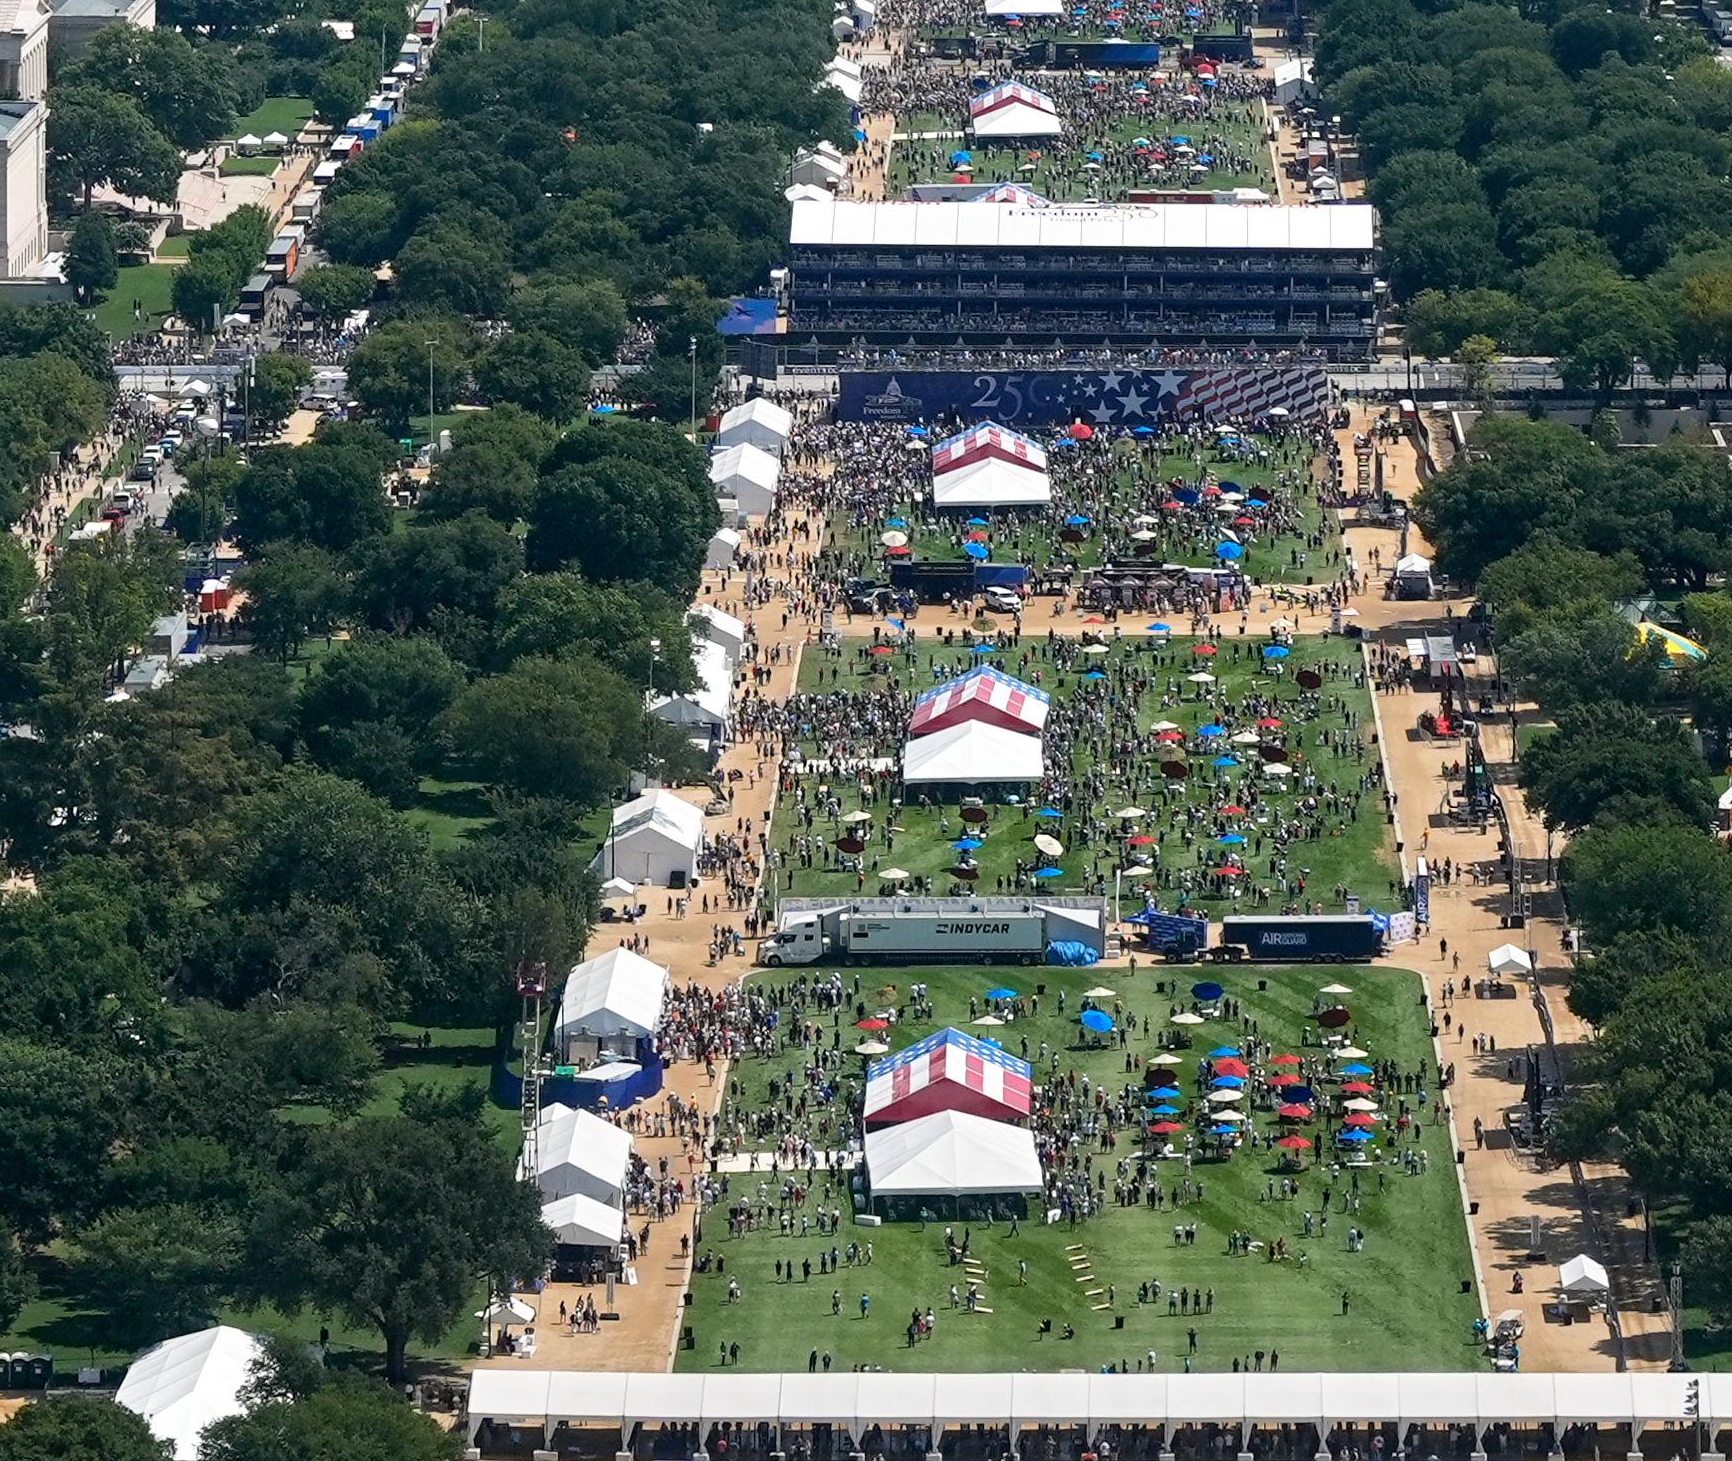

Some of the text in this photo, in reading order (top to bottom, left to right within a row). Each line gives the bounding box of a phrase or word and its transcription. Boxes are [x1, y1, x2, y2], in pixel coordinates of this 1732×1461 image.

[1103, 208, 1158, 222] 250
[1417, 900, 1428, 922] AIR
[950, 923, 1010, 934] INDYCAR
[1261, 932, 1282, 945] AIR
